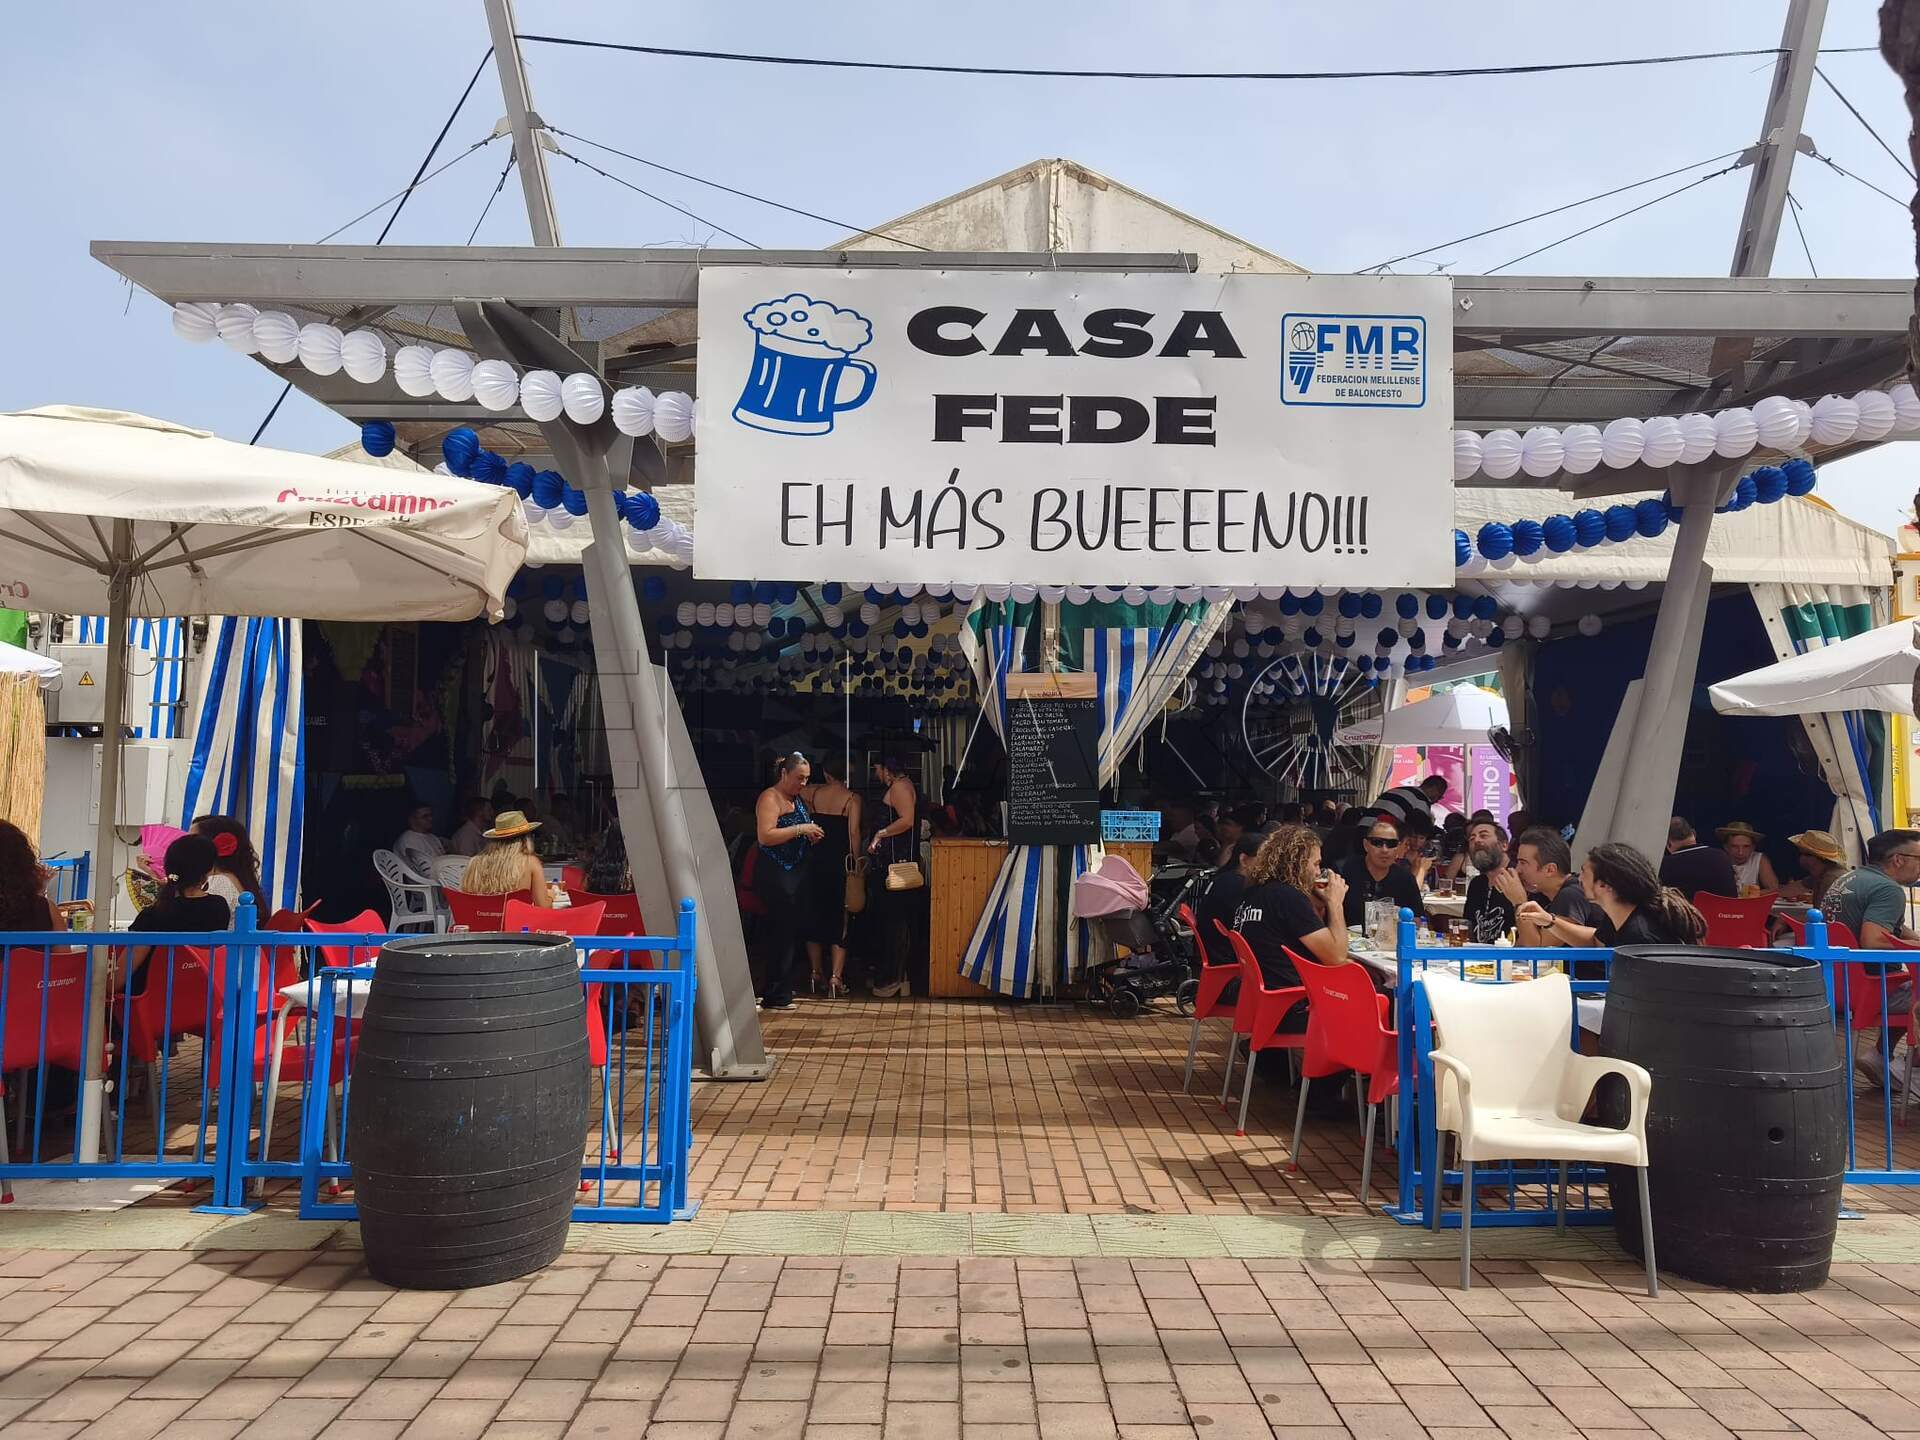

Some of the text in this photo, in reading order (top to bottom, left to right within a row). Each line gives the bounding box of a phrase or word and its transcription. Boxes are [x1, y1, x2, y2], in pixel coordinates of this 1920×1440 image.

[906, 305, 1247, 359] CASA
[1316, 374, 1420, 386] FEDERACION MELILLENSE
[1335, 388, 1402, 398] DE BALONCESTO
[931, 392, 1217, 448] FEDE
[781, 467, 1368, 555] EH MÁS BUEEEENO!!!
[37, 977, 77, 989] Cuzcampo
